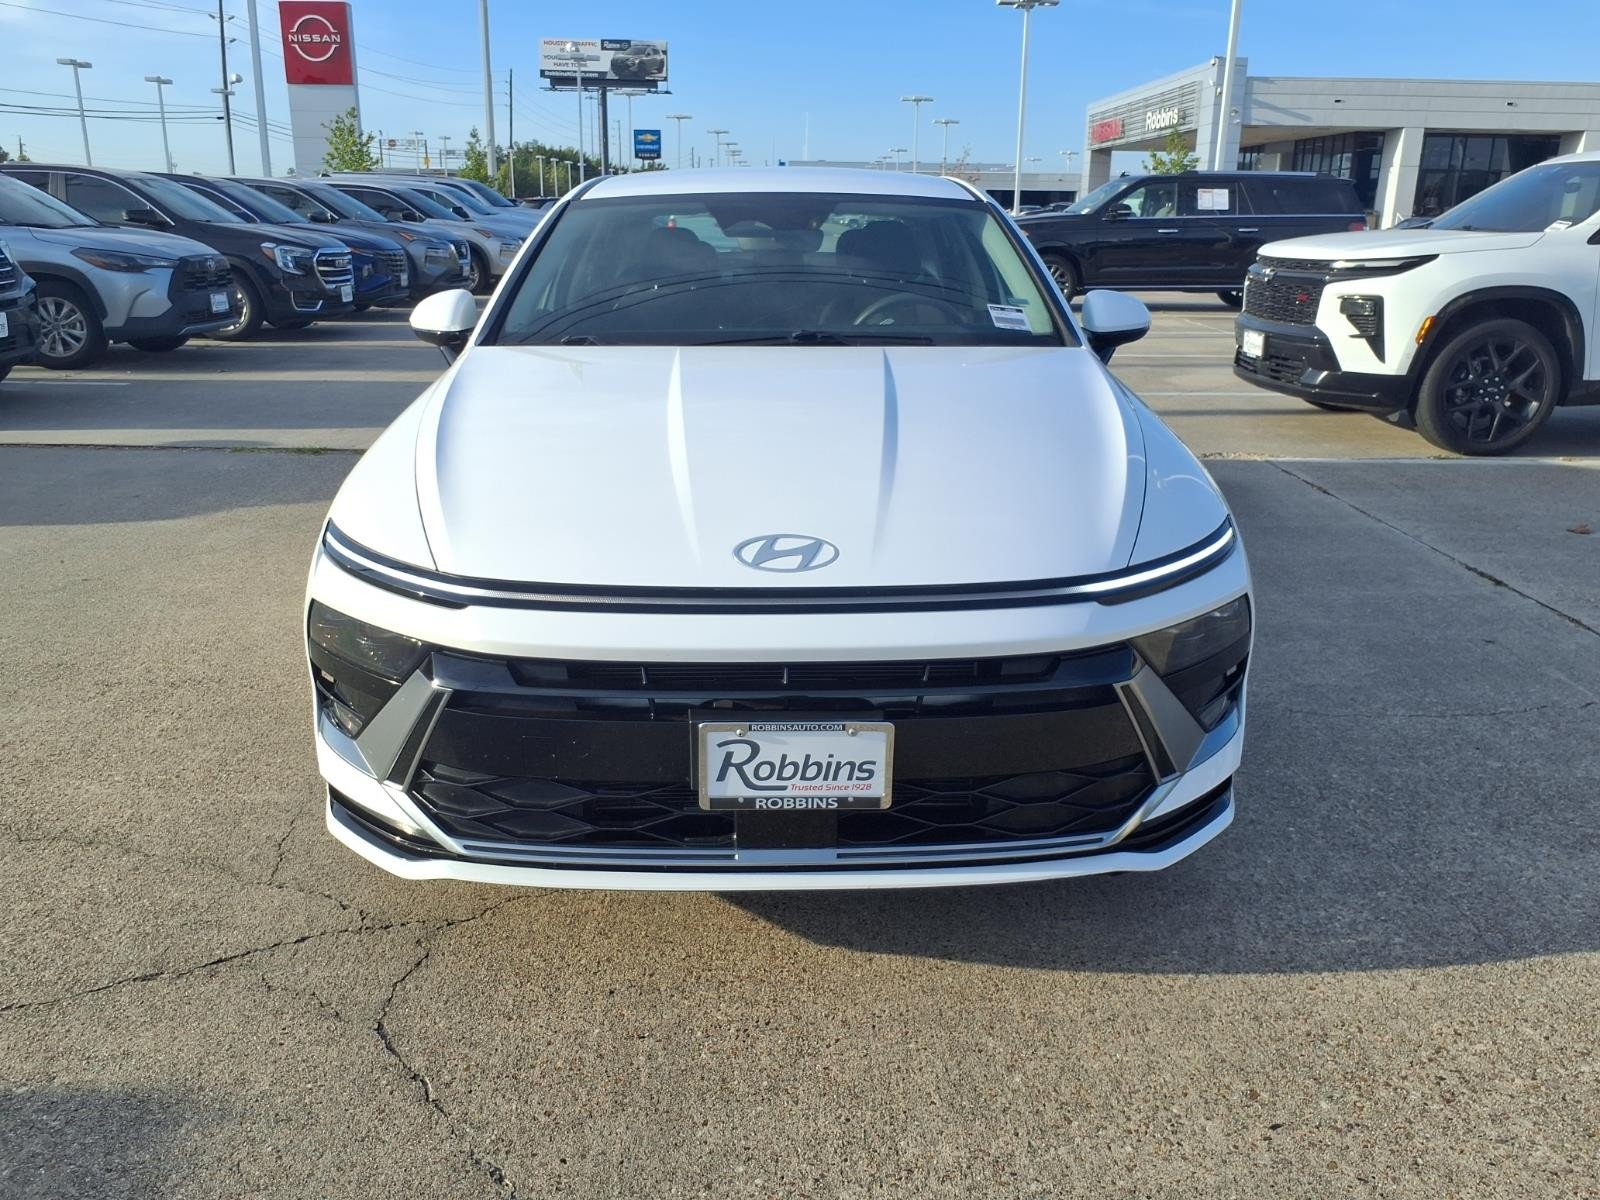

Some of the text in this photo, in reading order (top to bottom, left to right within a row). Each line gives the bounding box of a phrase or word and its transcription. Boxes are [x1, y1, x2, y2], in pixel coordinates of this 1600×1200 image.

[288, 34, 341, 42] NISSAN
[1145, 107, 1179, 131] Robbins
[716, 739, 877, 791] Robbins
[790, 783, 872, 791] Trusted Since 1928
[755, 797, 839, 809] ROBBINS
